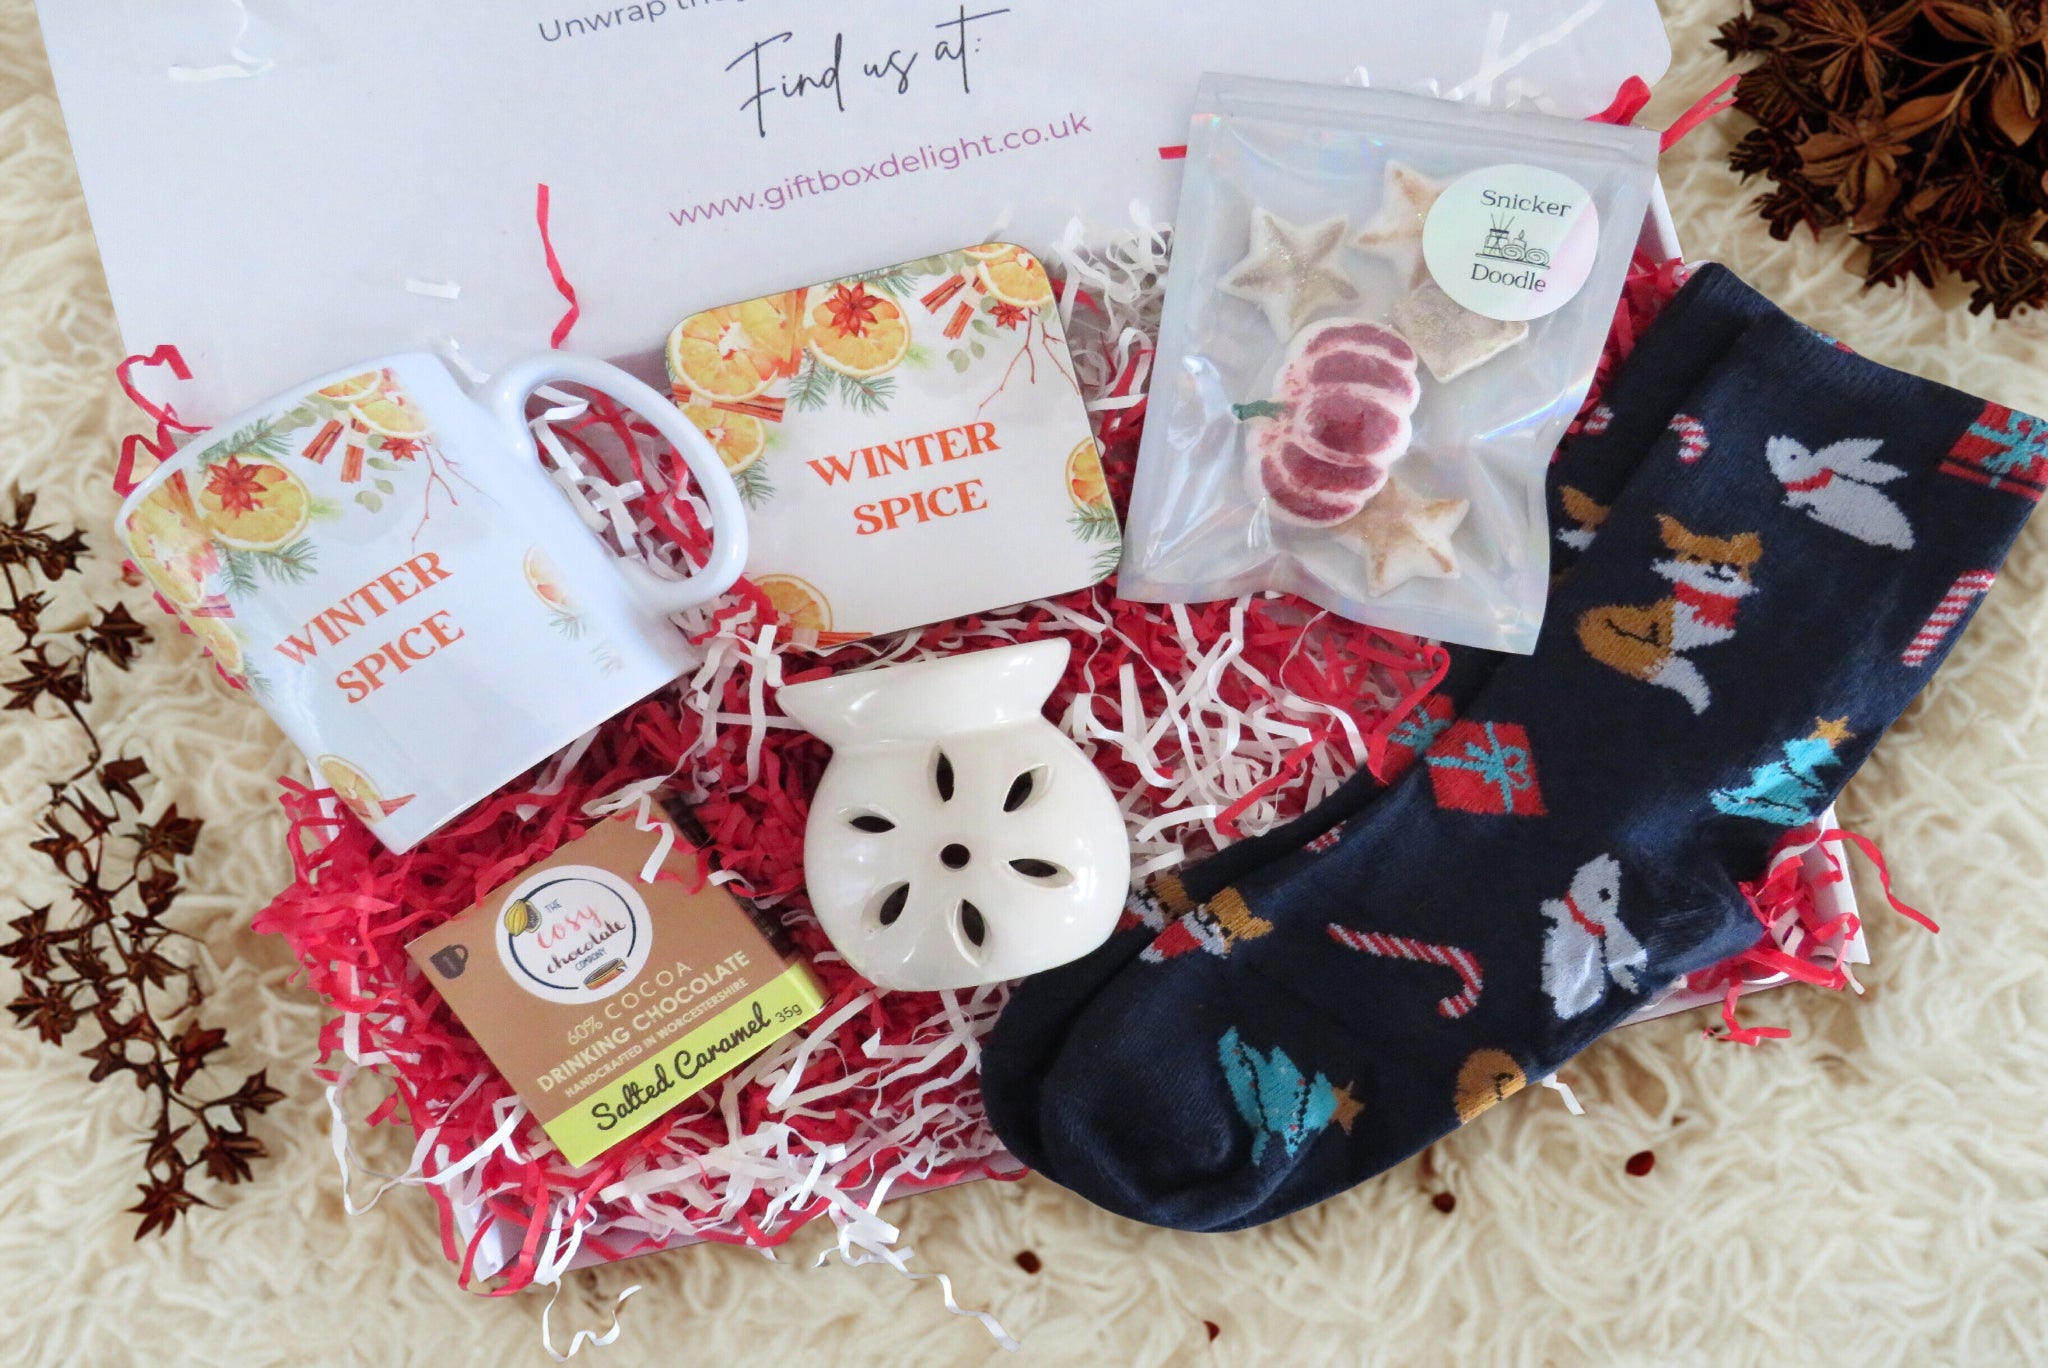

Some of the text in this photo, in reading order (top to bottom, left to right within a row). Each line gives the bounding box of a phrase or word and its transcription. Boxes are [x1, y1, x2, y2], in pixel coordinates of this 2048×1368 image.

[538, 0, 667, 43] Unwrap
[725, 32, 845, 138] Find
[863, 51, 918, 94] us
[669, 113, 1093, 227] www.giftboxdelight.co.uk
[1480, 190, 1572, 217] Snicker
[1471, 263, 1546, 292] Doodle
[806, 421, 1002, 486] WINTER
[853, 479, 987, 535] SPICE
[274, 552, 453, 664] WINTER
[336, 609, 465, 703] SPICE
[544, 899, 562, 913] THE
[547, 919, 627, 973] chocolate
[575, 947, 606, 971] COMPANY
[536, 950, 751, 1092] DRINKING CHOCOLATE
[565, 977, 749, 1098] HANDCRAFTED IN WORCESTERSHIRE
[567, 961, 692, 1045] 60% COCOA
[591, 1001, 803, 1131] Salted Caramel 35g
